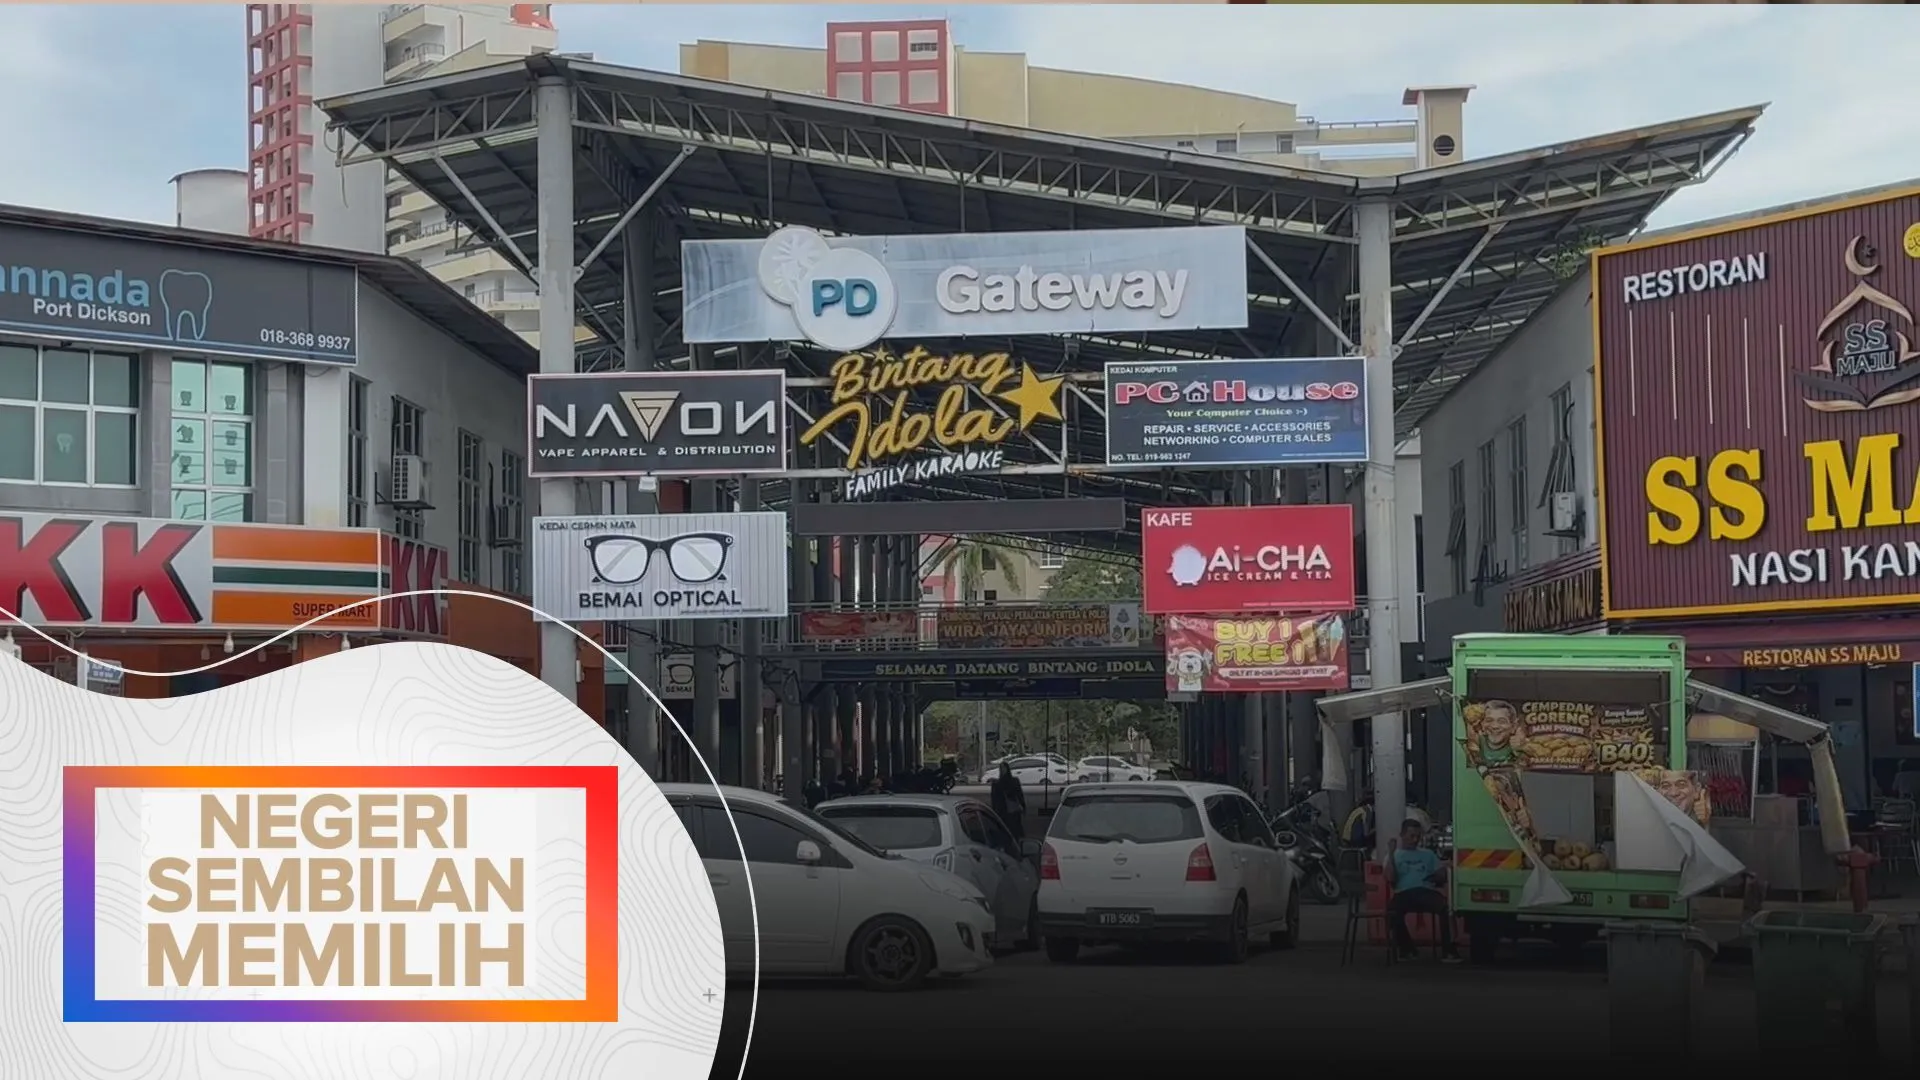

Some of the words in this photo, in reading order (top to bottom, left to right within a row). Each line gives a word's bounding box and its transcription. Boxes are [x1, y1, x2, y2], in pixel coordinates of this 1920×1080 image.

[0, 264, 150, 307] nnada
[1623, 252, 1766, 303] RESTORAN
[812, 278, 877, 317] PD
[936, 263, 1190, 318] Gateway
[33, 298, 73, 317] Port
[78, 303, 151, 326] Dickson
[260, 328, 314, 347] 018-368
[318, 333, 351, 350] 9937
[1844, 319, 1889, 355] SS
[830, 345, 1016, 402] Bintang
[1110, 366, 1134, 374] KEDAI
[1135, 366, 1178, 374] KOMPUTER
[1837, 350, 1896, 376] MAJU
[1115, 381, 1180, 405] PC
[1213, 380, 1359, 402] House
[1166, 409, 1194, 419] Your
[1196, 408, 1252, 419] Computer
[1254, 406, 1293, 416] Choice
[799, 383, 1016, 470] Idola
[1143, 424, 1185, 434] REPAIR
[1193, 423, 1242, 433] SERVICE
[1250, 421, 1332, 432] ACCESSORIES
[538, 449, 575, 457] VAPE
[581, 447, 647, 457] APPAREL
[657, 447, 668, 456] &
[674, 445, 777, 456] DISTRIBUTION
[1143, 435, 1220, 446] NETWORKING
[1229, 434, 1292, 444] COMPUTER
[1294, 433, 1332, 443] SALES
[846, 463, 911, 500] FAMILY
[914, 450, 1004, 480] KARAOKE
[1645, 448, 1766, 546] SS
[1804, 433, 1920, 532] M
[539, 522, 569, 531] KEDAI
[571, 521, 608, 531] CERMIN
[609, 520, 637, 530] MATA
[1146, 512, 1193, 527] KAFE
[1207, 543, 1332, 572] Ai-CHA
[1730, 548, 1828, 587] NASI
[0, 516, 205, 624] KK
[1207, 573, 1230, 582] ICE
[1237, 571, 1283, 581] CREAM
[1306, 571, 1333, 580] TEA
[391, 537, 439, 634] KK
[292, 602, 335, 617] SUPER
[579, 591, 643, 609] BEMAI
[653, 589, 742, 608] OPTICAL
[943, 622, 985, 637] WIRA
[989, 621, 1026, 637] JAYA
[1034, 620, 1107, 636] UNIFORM
[1214, 619, 1274, 642] BUY
[1278, 618, 1293, 642] 1
[1214, 642, 1289, 667] FREE
[1743, 648, 1827, 666] RESTORAN
[1830, 647, 1850, 664] SS
[1853, 644, 1901, 662] MAJU
[875, 663, 947, 675] SELAMAT
[955, 663, 1020, 675] DATANG
[1028, 661, 1098, 674] BINTANG
[1106, 660, 1155, 673] IDOLA
[1522, 701, 1594, 715] CEMPEDAK
[1525, 711, 1590, 726] GORENG
[1600, 742, 1649, 764] B40
